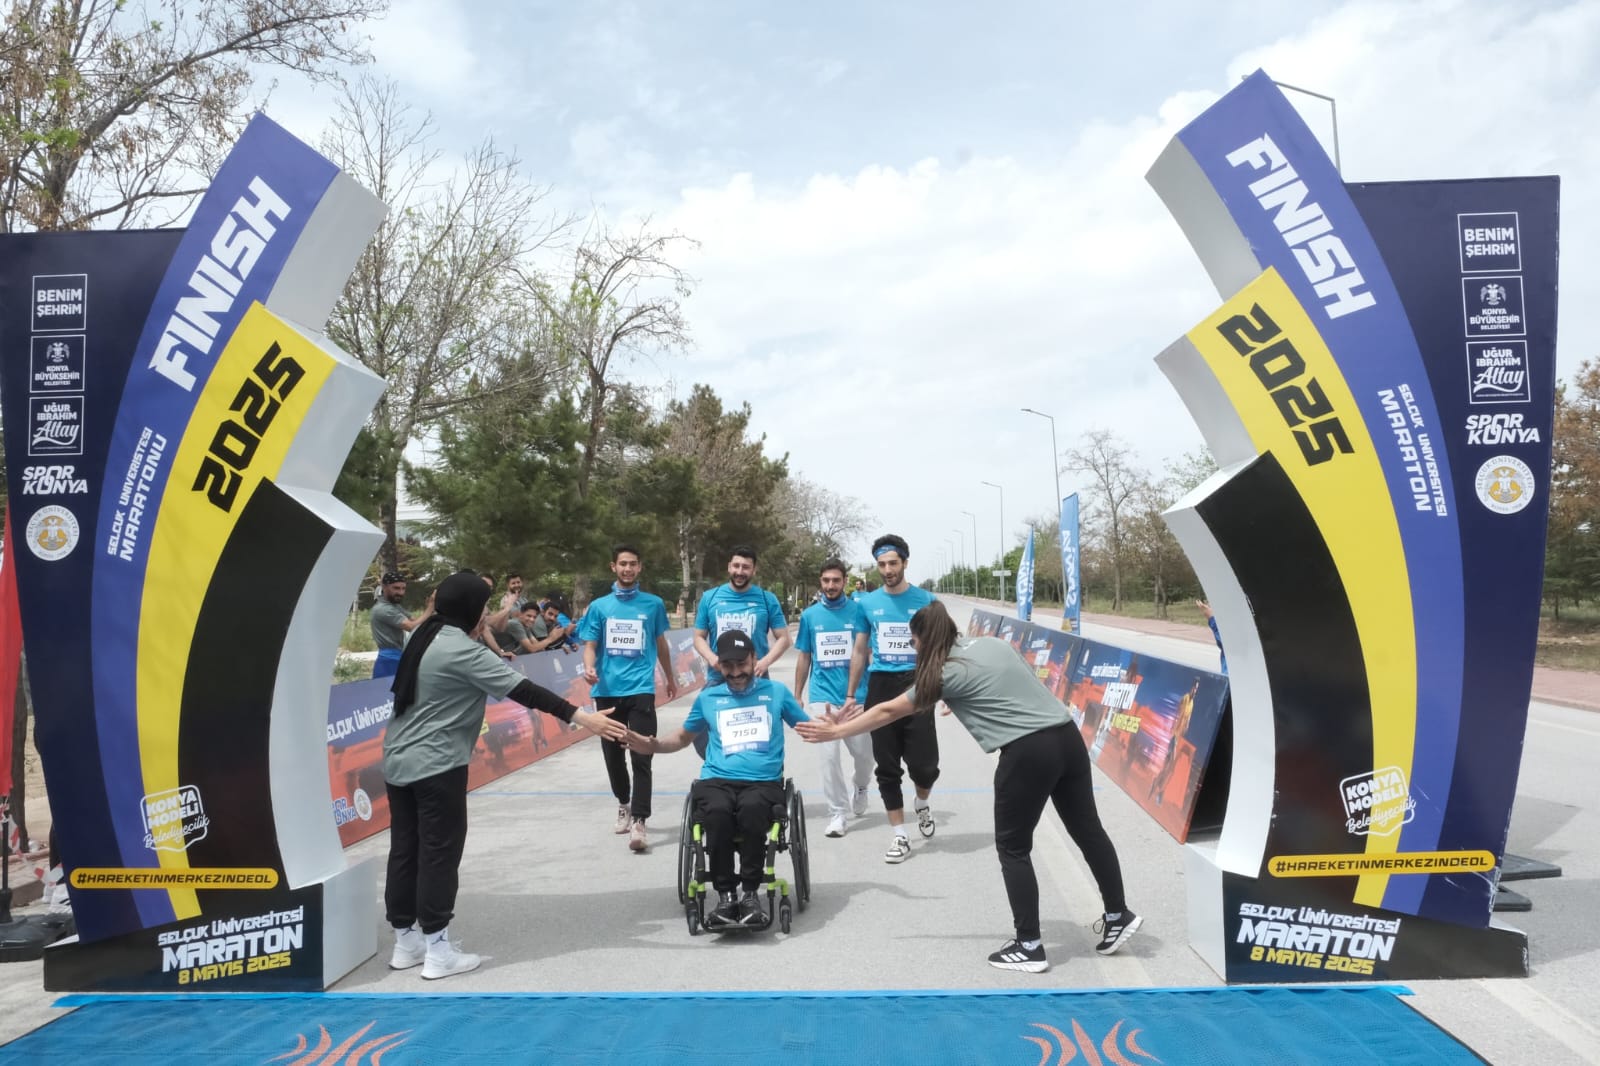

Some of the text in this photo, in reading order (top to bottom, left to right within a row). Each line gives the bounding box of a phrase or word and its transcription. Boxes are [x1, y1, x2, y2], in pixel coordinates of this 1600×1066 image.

[1225, 132, 1377, 319] FINISH
[148, 175, 292, 392] FINISH
[1482, 346, 1513, 358] UĞUR
[1216, 302, 1355, 467] 2025
[1473, 366, 1525, 393] Altay
[43, 402, 71, 412] UĞUR
[1398, 383, 1425, 428] SELCUK
[31, 420, 80, 446] Altay
[191, 340, 306, 513] 2025
[1465, 413, 1524, 430] SPOR
[1467, 424, 1541, 445] KONYA
[1377, 388, 1432, 512] MARATON
[22, 465, 75, 482] SPOR
[22, 475, 88, 495] KONYA
[119, 434, 168, 562] MARATONU
[107, 510, 126, 556] SELCUK
[823, 648, 846, 656] 6409
[888, 641, 910, 649] 7152
[327, 716, 356, 742] ELÇUK
[732, 727, 758, 738] 7150
[1346, 771, 1401, 800] KONYA
[146, 790, 198, 816] KONYA
[1275, 856, 1489, 873] #HAREKETINMERKEZINDEOL
[76, 872, 272, 885] #HAREKETINMERKEZINDEOL
[162, 923, 304, 972] MARATON
[1236, 918, 1396, 961] MARATON
[178, 951, 292, 985] 8 MAYIS 2025
[1250, 946, 1376, 975] 8 MAYIS 2025
